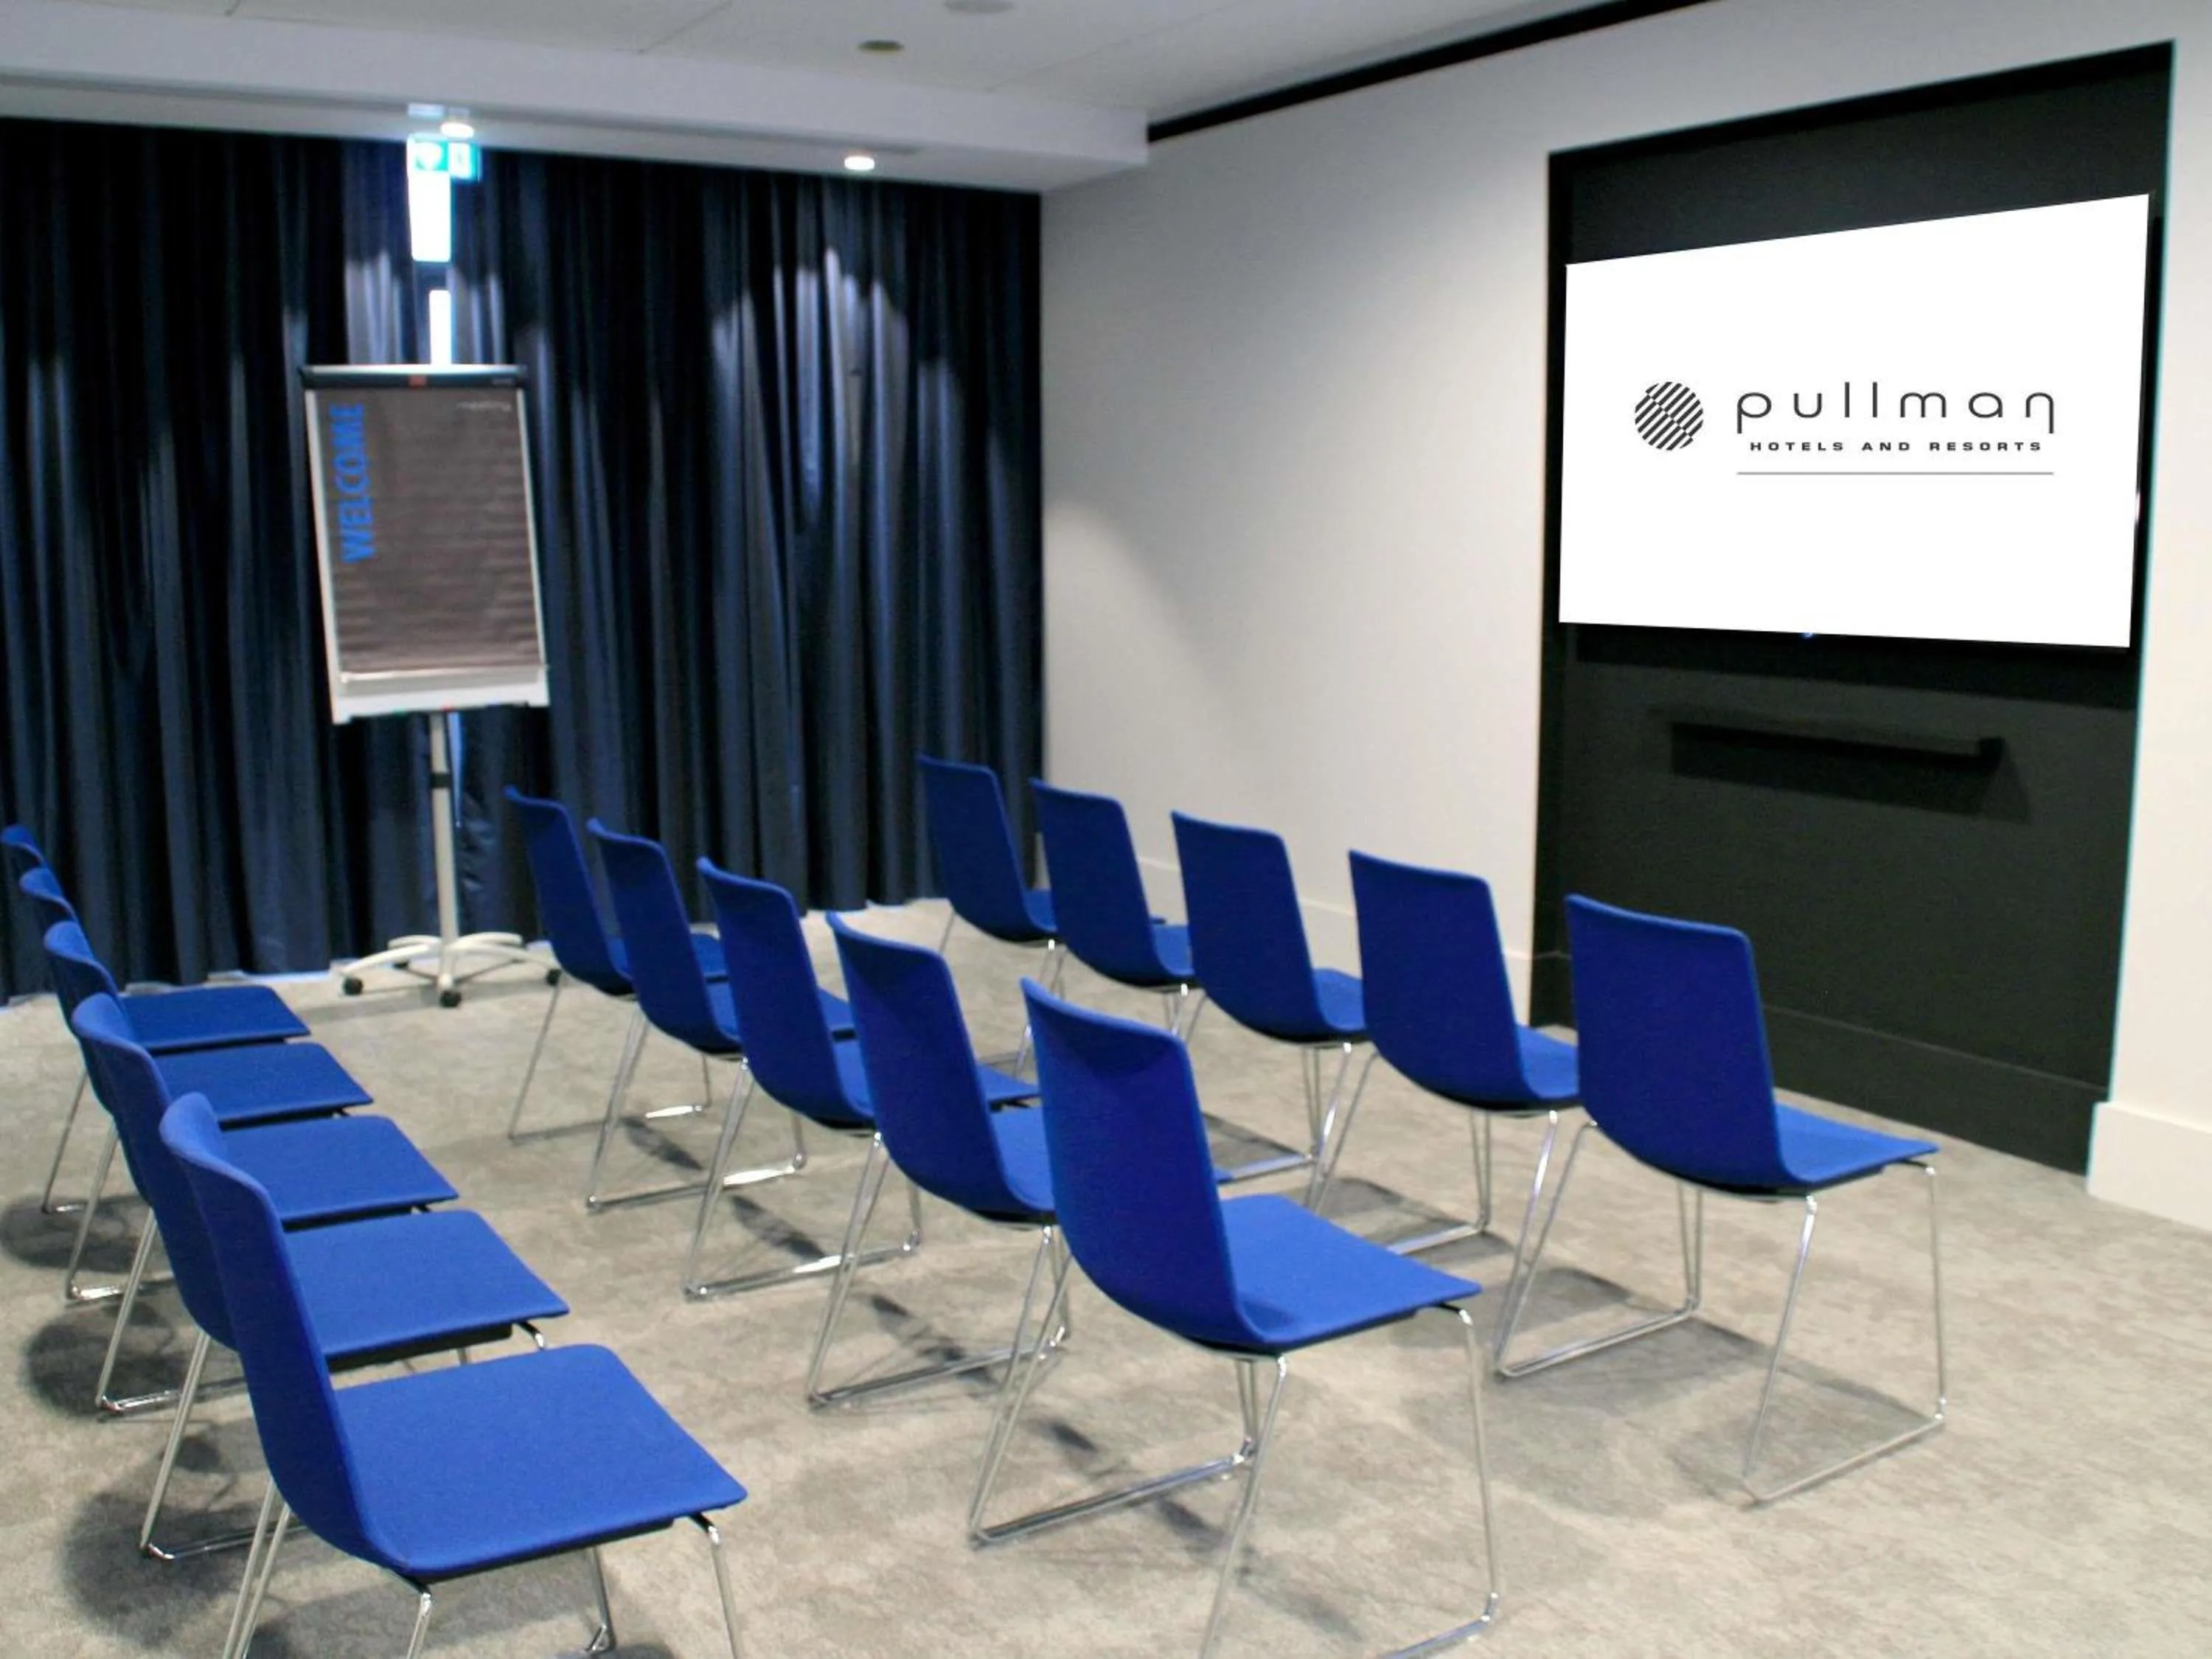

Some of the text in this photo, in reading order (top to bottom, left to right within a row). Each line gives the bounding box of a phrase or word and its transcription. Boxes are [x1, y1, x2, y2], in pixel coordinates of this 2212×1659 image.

[1737, 381, 2054, 434] pullman
[1750, 442, 2042, 452] HOTELS AND RESORTS
[329, 403, 377, 563] WELCOME
